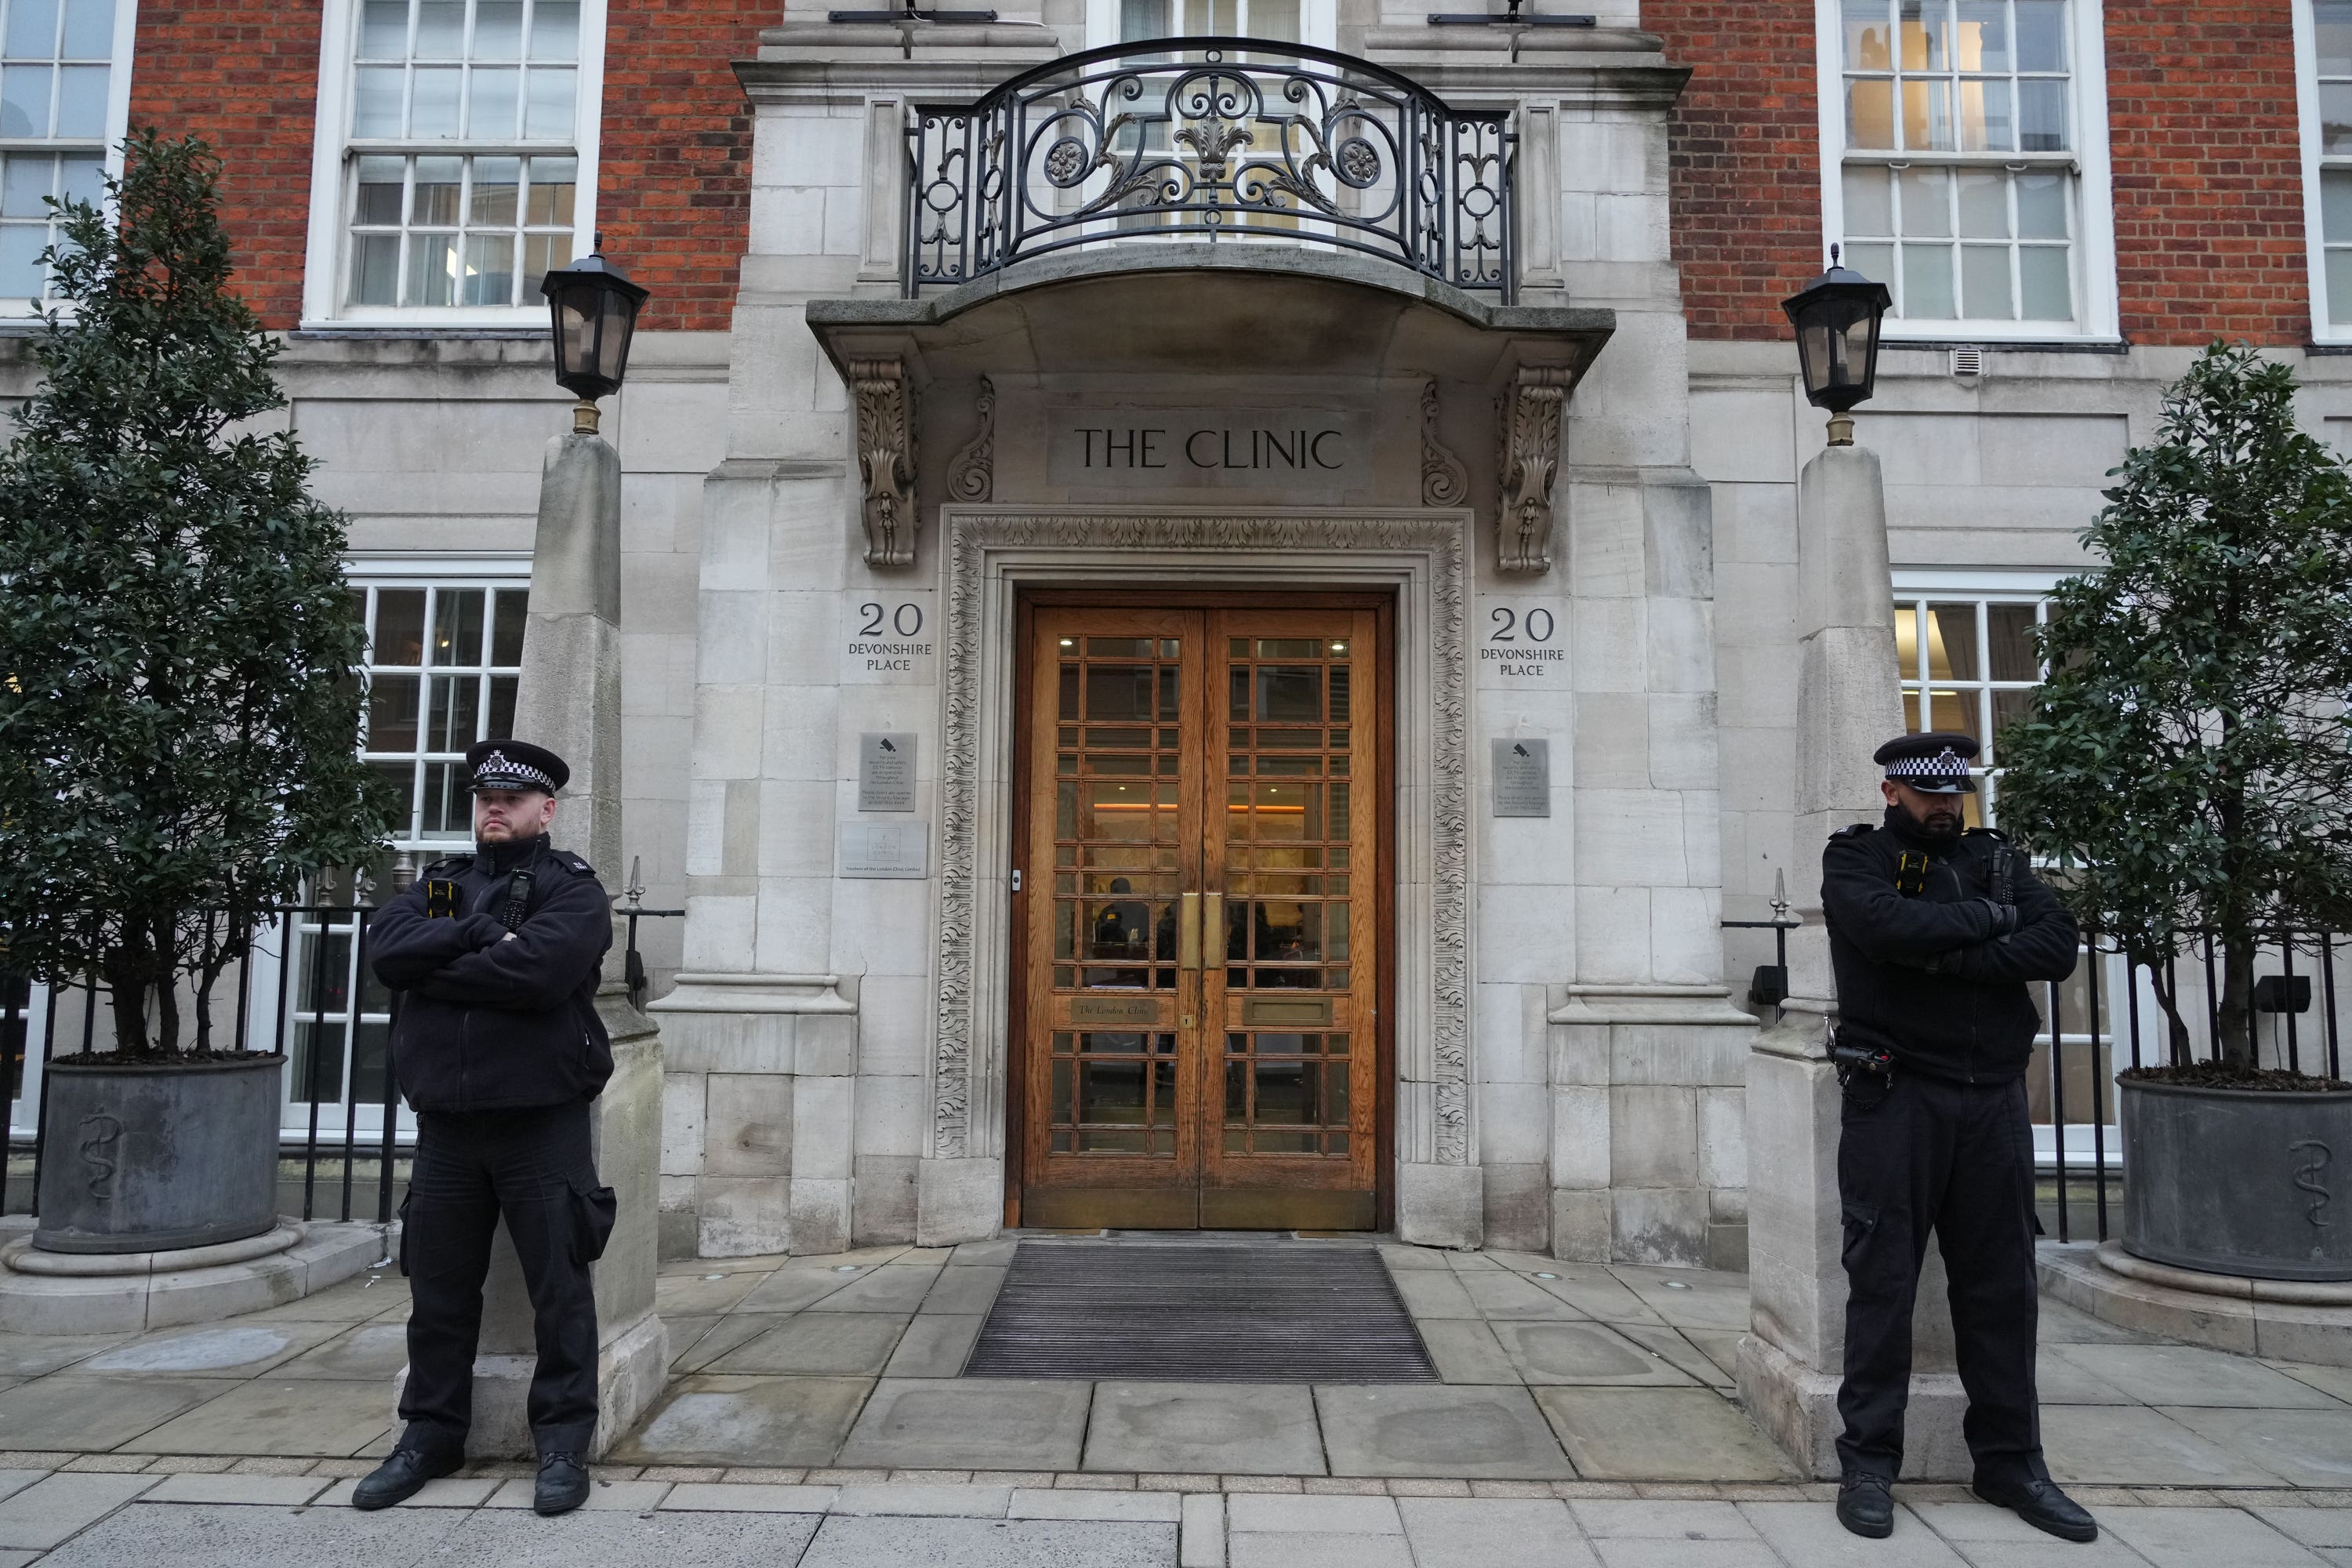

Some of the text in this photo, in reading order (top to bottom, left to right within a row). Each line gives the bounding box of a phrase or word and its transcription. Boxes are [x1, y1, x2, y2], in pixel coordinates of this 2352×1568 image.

[1074, 430, 1344, 468] THE CLINIC
[859, 603, 923, 637] 20
[1490, 608, 1554, 641] 20
[849, 644, 931, 655] DEVONSHIRE
[1481, 649, 1564, 660] DEVONSHIRE
[867, 660, 910, 670] PLACE
[1501, 665, 1544, 675] PLACE
[1079, 1005, 1149, 1014] The London Clinic
